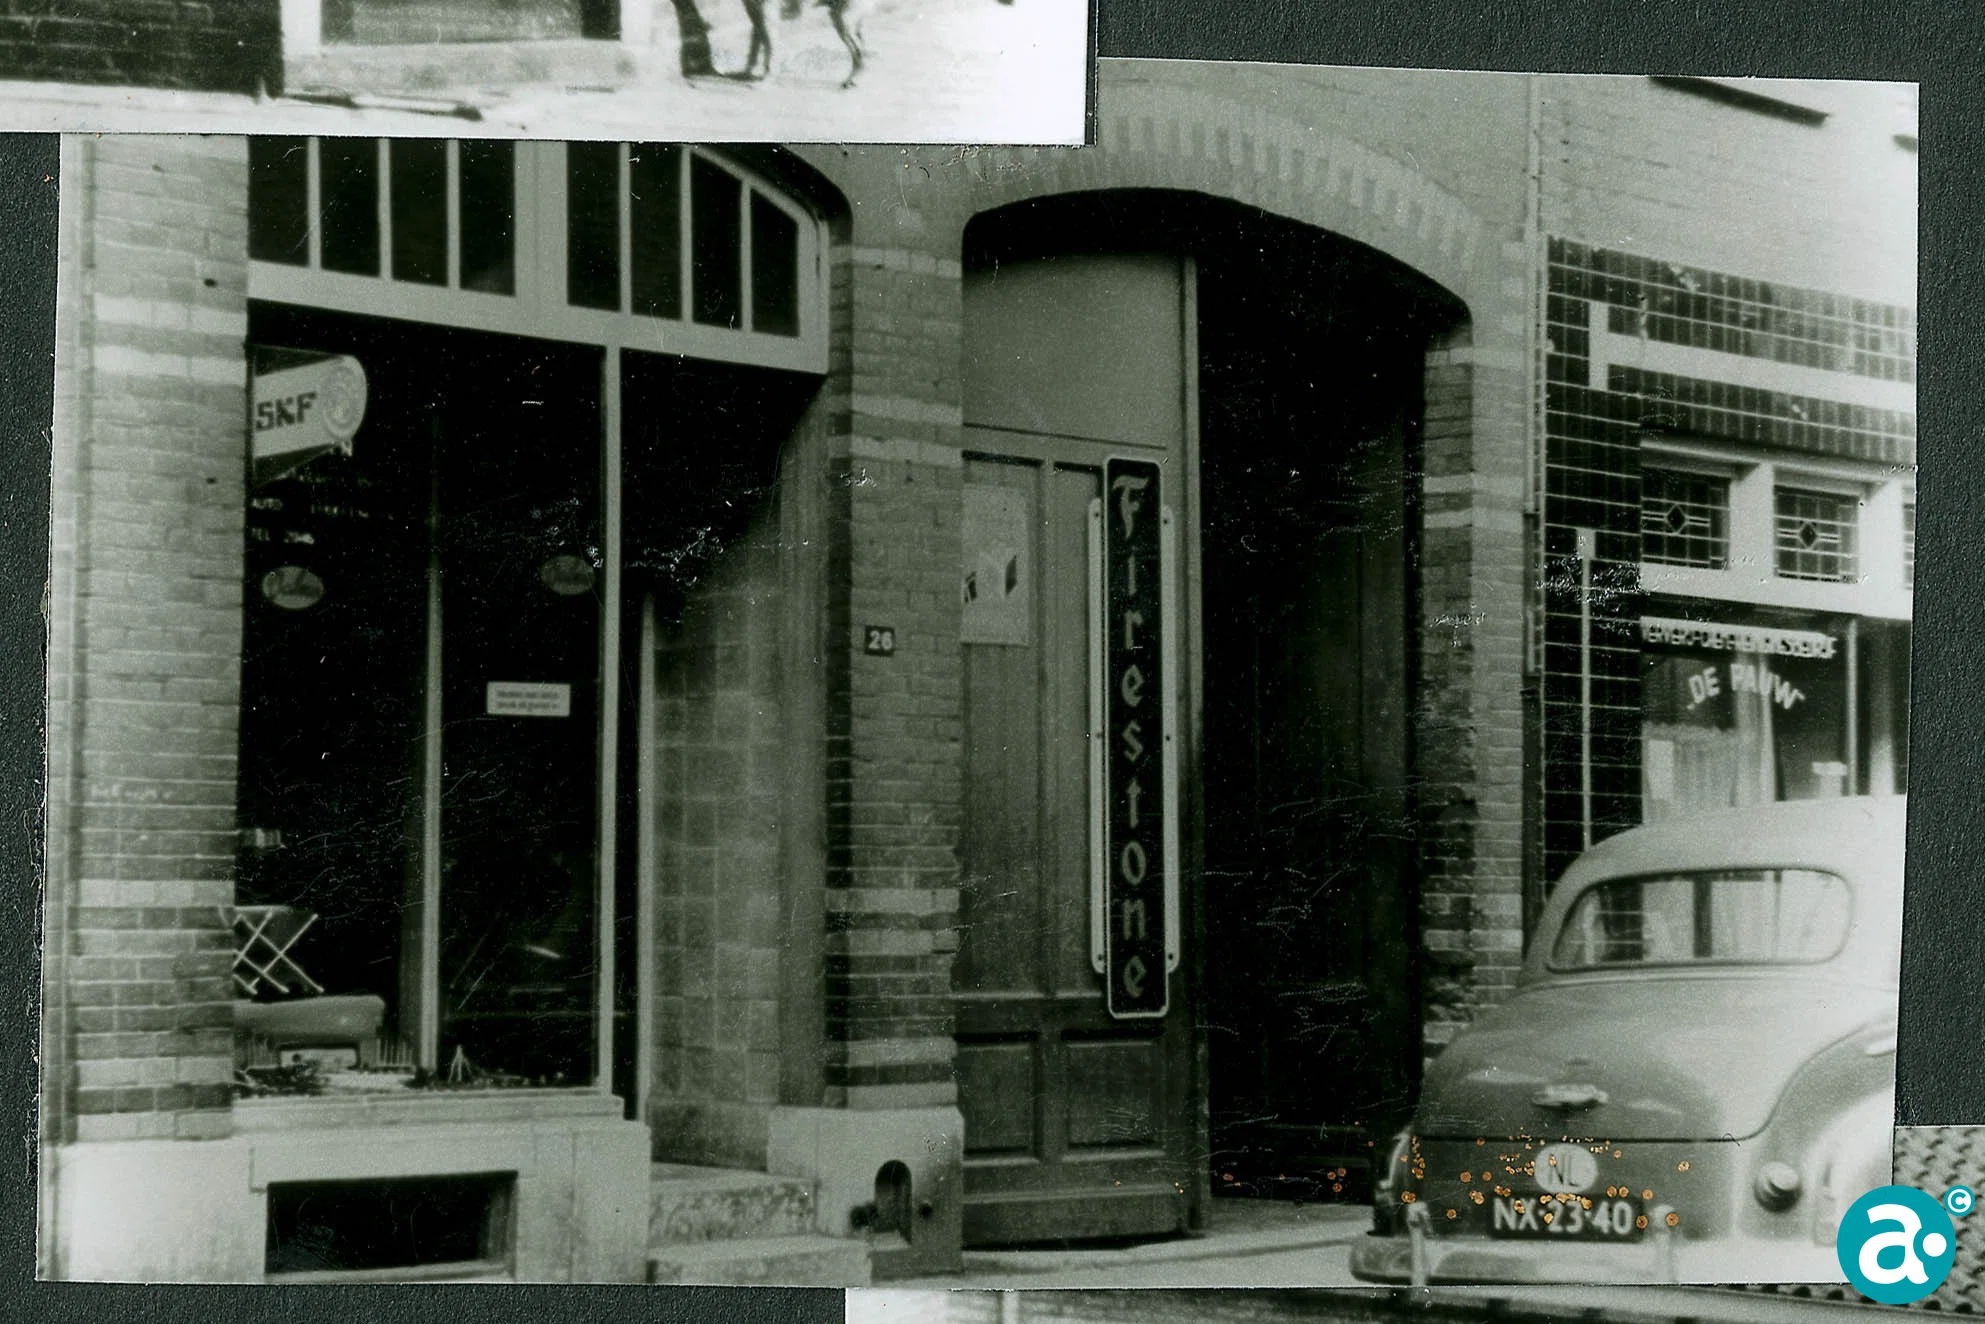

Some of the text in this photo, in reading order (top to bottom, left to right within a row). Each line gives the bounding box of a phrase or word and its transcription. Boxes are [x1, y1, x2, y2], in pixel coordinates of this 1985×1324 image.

[255, 391, 317, 431] SKF
[1111, 473, 1150, 999] Firestone
[1550, 1152, 1583, 1188] NL
